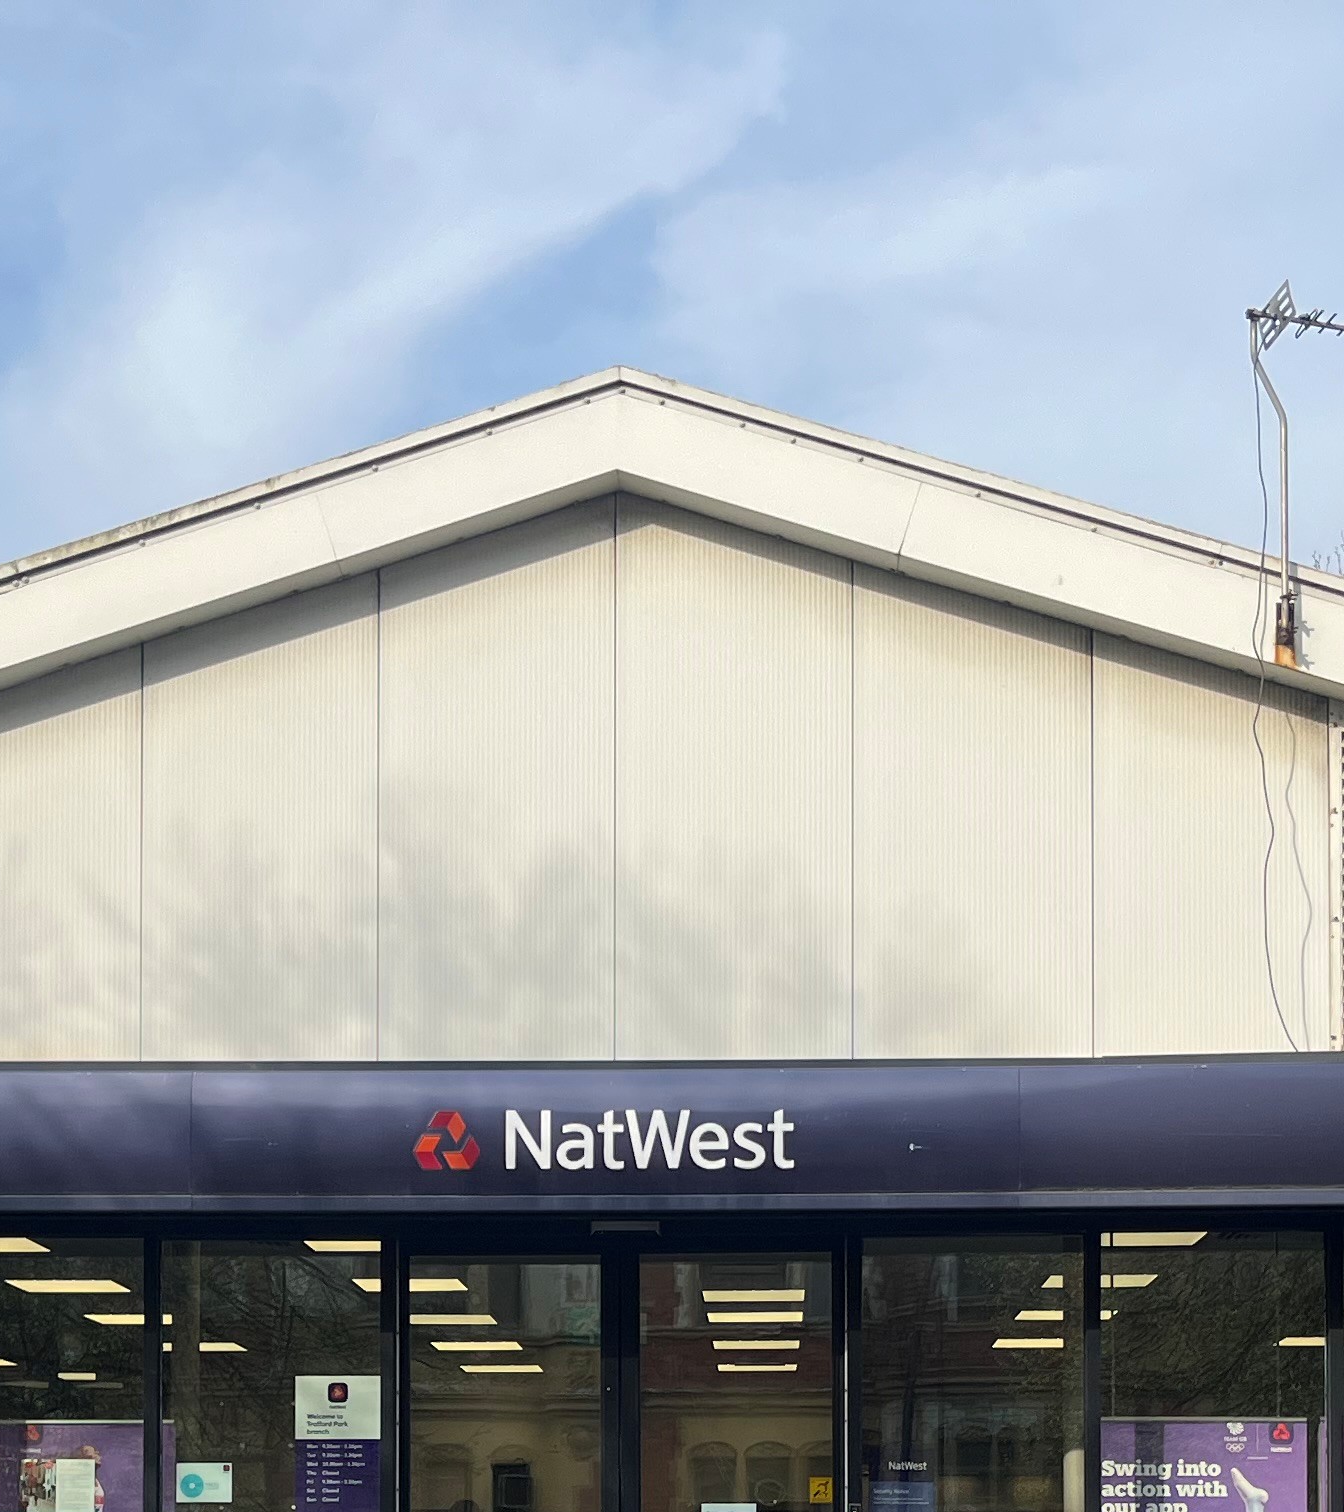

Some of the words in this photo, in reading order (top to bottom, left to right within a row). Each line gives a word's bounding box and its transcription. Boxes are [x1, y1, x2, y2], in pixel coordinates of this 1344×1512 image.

[504, 1108, 795, 1171] NatWest
[888, 1460, 928, 1471] NatWest
[1101, 1459, 1172, 1480] Swing
[1176, 1459, 1222, 1477] into
[1101, 1480, 1172, 1497] action
[1175, 1479, 1229, 1497] with
